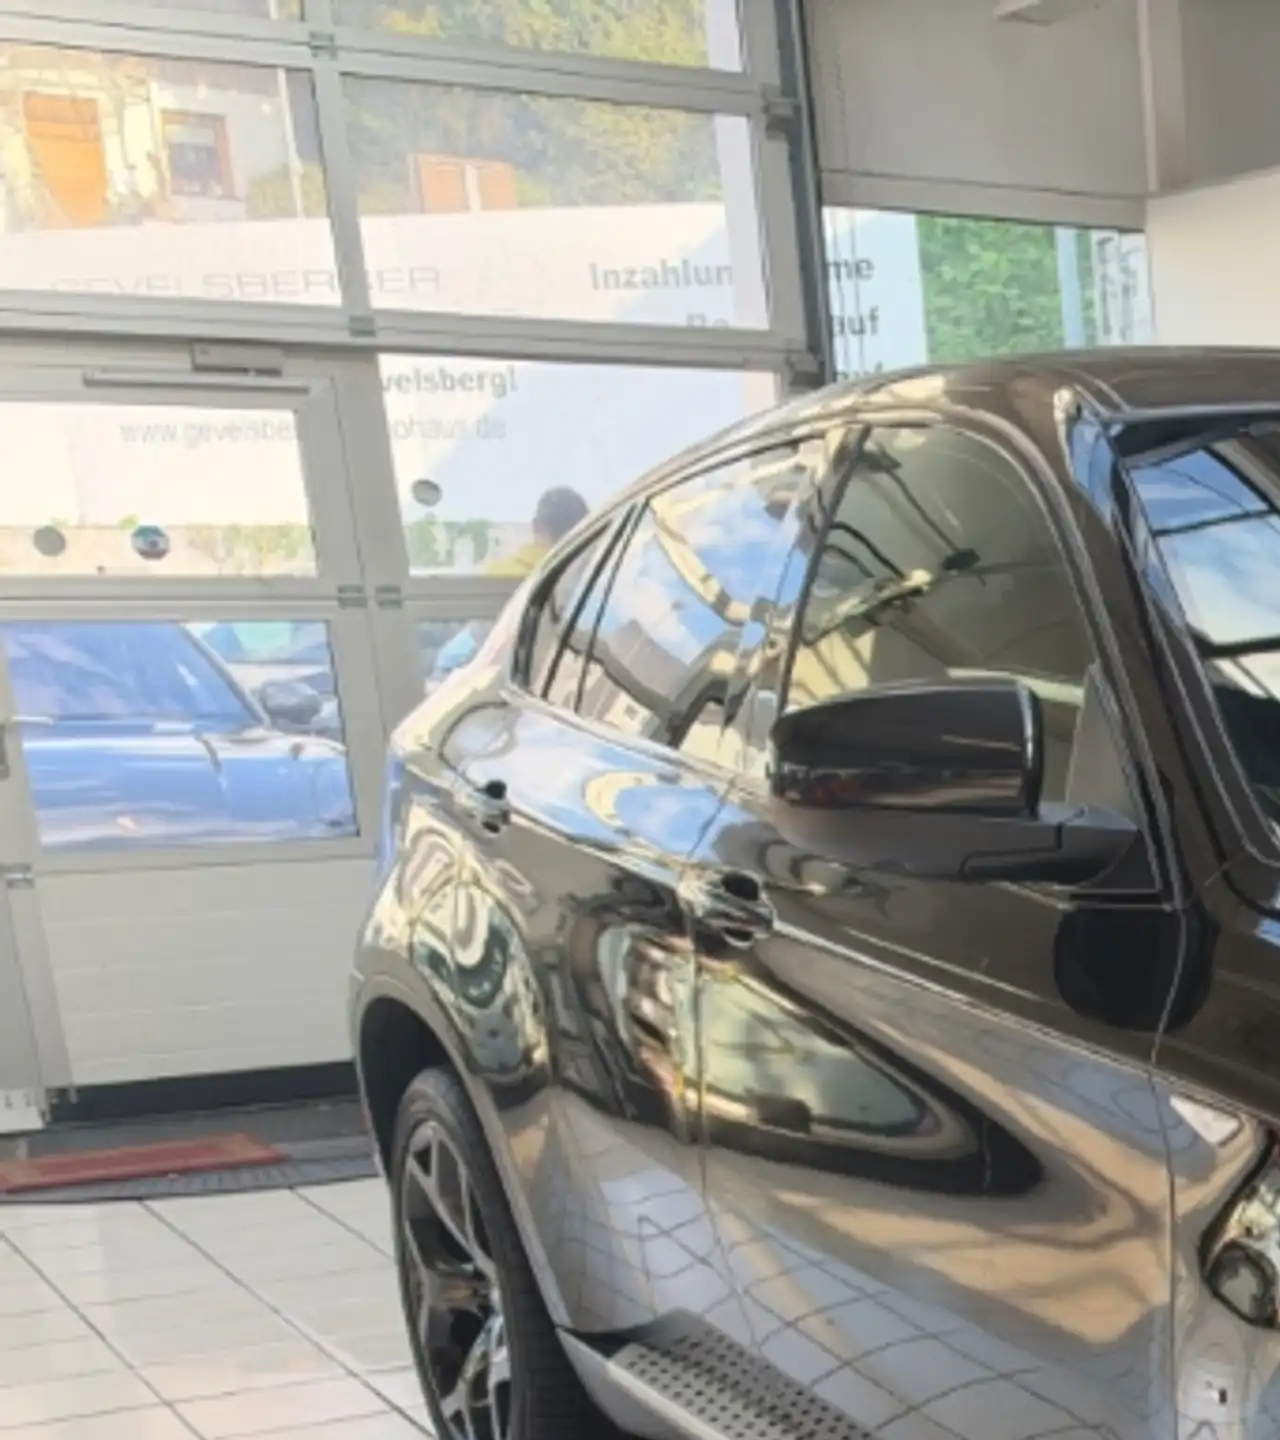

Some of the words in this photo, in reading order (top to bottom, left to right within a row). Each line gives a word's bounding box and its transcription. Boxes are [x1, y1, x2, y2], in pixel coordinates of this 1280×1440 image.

[50, 265, 439, 298] GEVELSBERER
[589, 257, 874, 290] Inzahlunme
[379, 364, 519, 400] velsberg!
